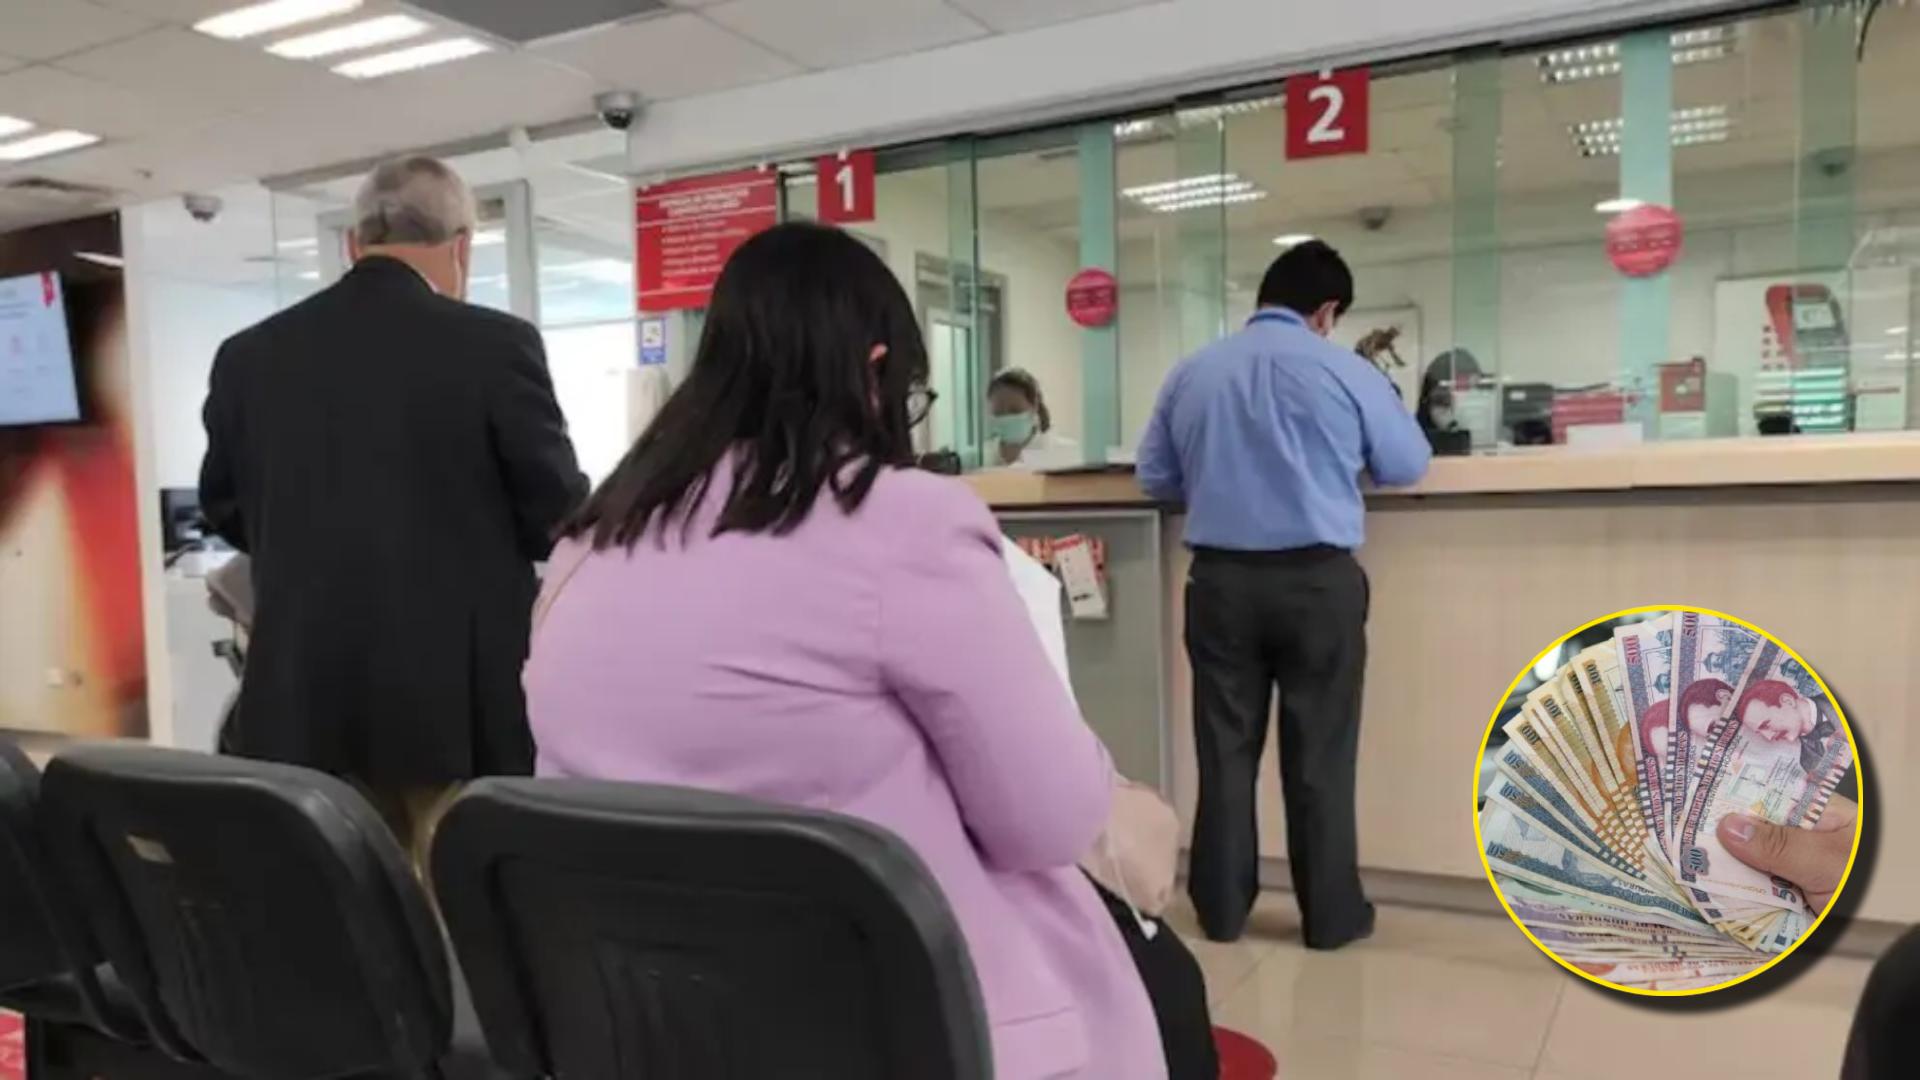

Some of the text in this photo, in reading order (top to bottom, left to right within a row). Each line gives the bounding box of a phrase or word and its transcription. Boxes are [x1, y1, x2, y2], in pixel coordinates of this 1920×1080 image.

[1306, 84, 1344, 143] 2
[834, 165, 854, 212] 1
[1623, 636, 1641, 666] 500
[1586, 662, 1602, 685] 100
[1544, 697, 1562, 718] 100
[1521, 725, 1540, 745] 100
[1689, 848, 1703, 873] 500
